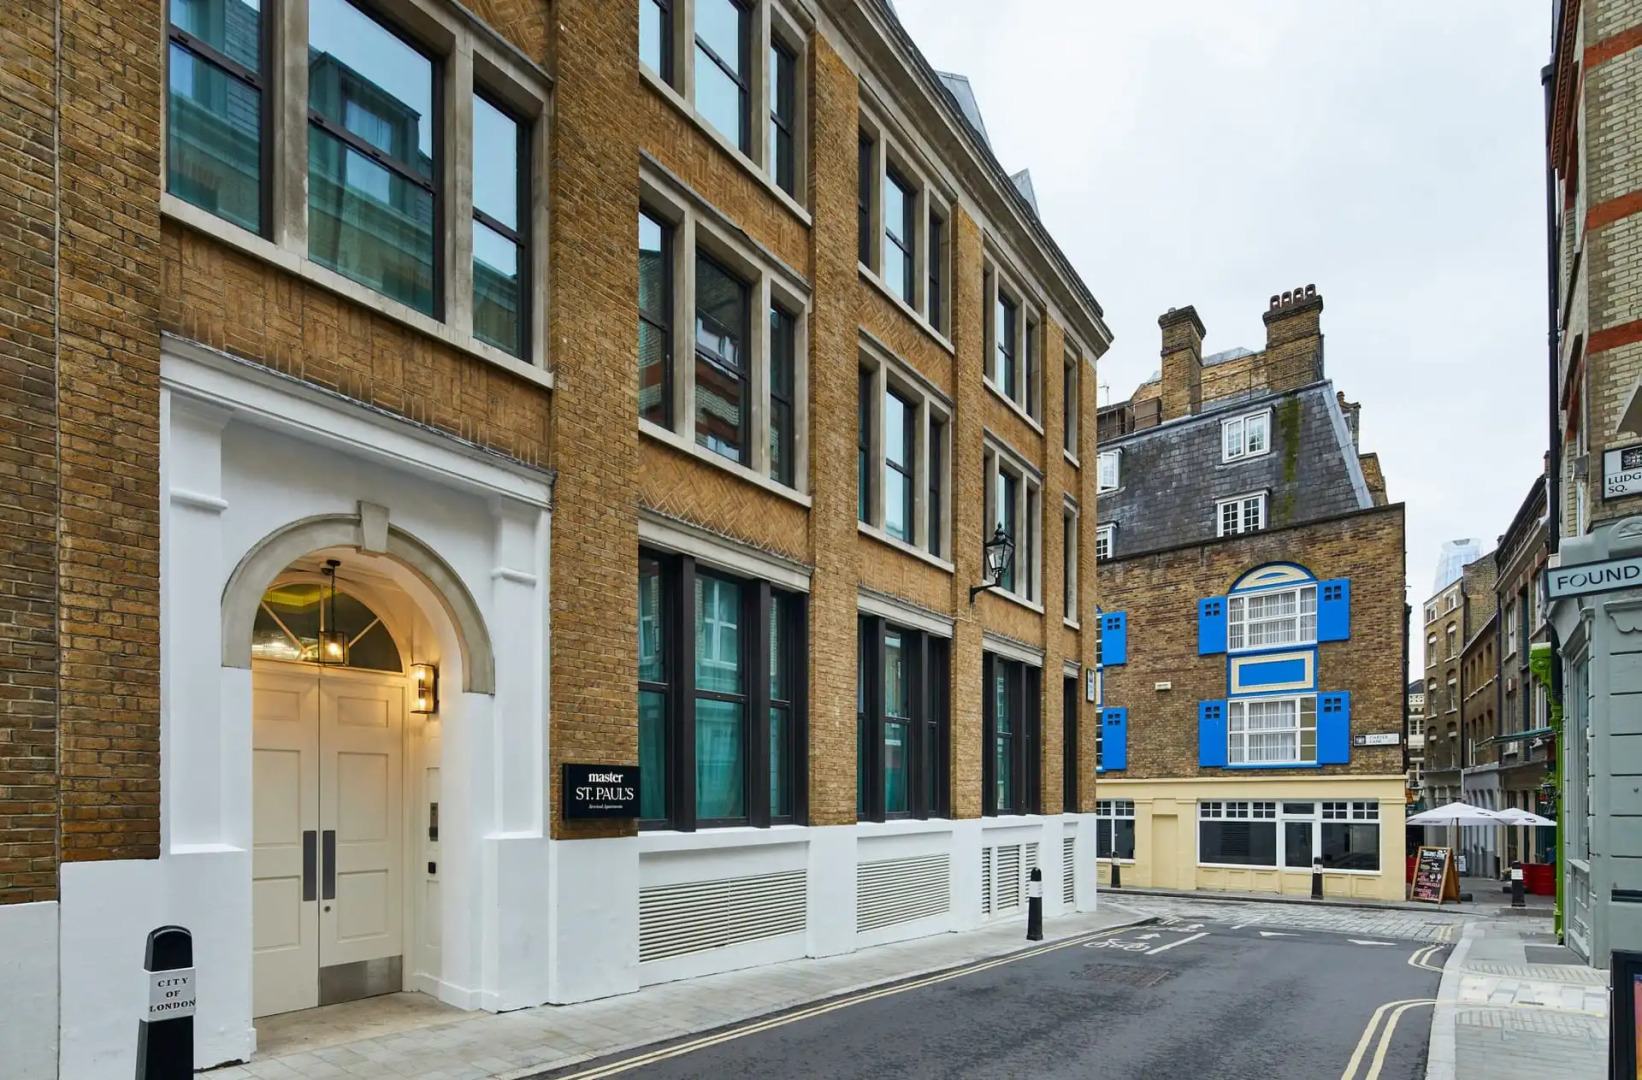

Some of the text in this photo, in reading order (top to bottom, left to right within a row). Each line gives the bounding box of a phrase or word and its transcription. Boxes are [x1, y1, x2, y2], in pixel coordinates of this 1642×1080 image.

[1557, 565, 1640, 590] FOUND
[588, 771, 624, 783] master
[575, 786, 634, 801] ST. PAUL'S
[157, 977, 189, 988] CITY
[165, 990, 181, 998] OF
[149, 997, 196, 1012] LONDON
